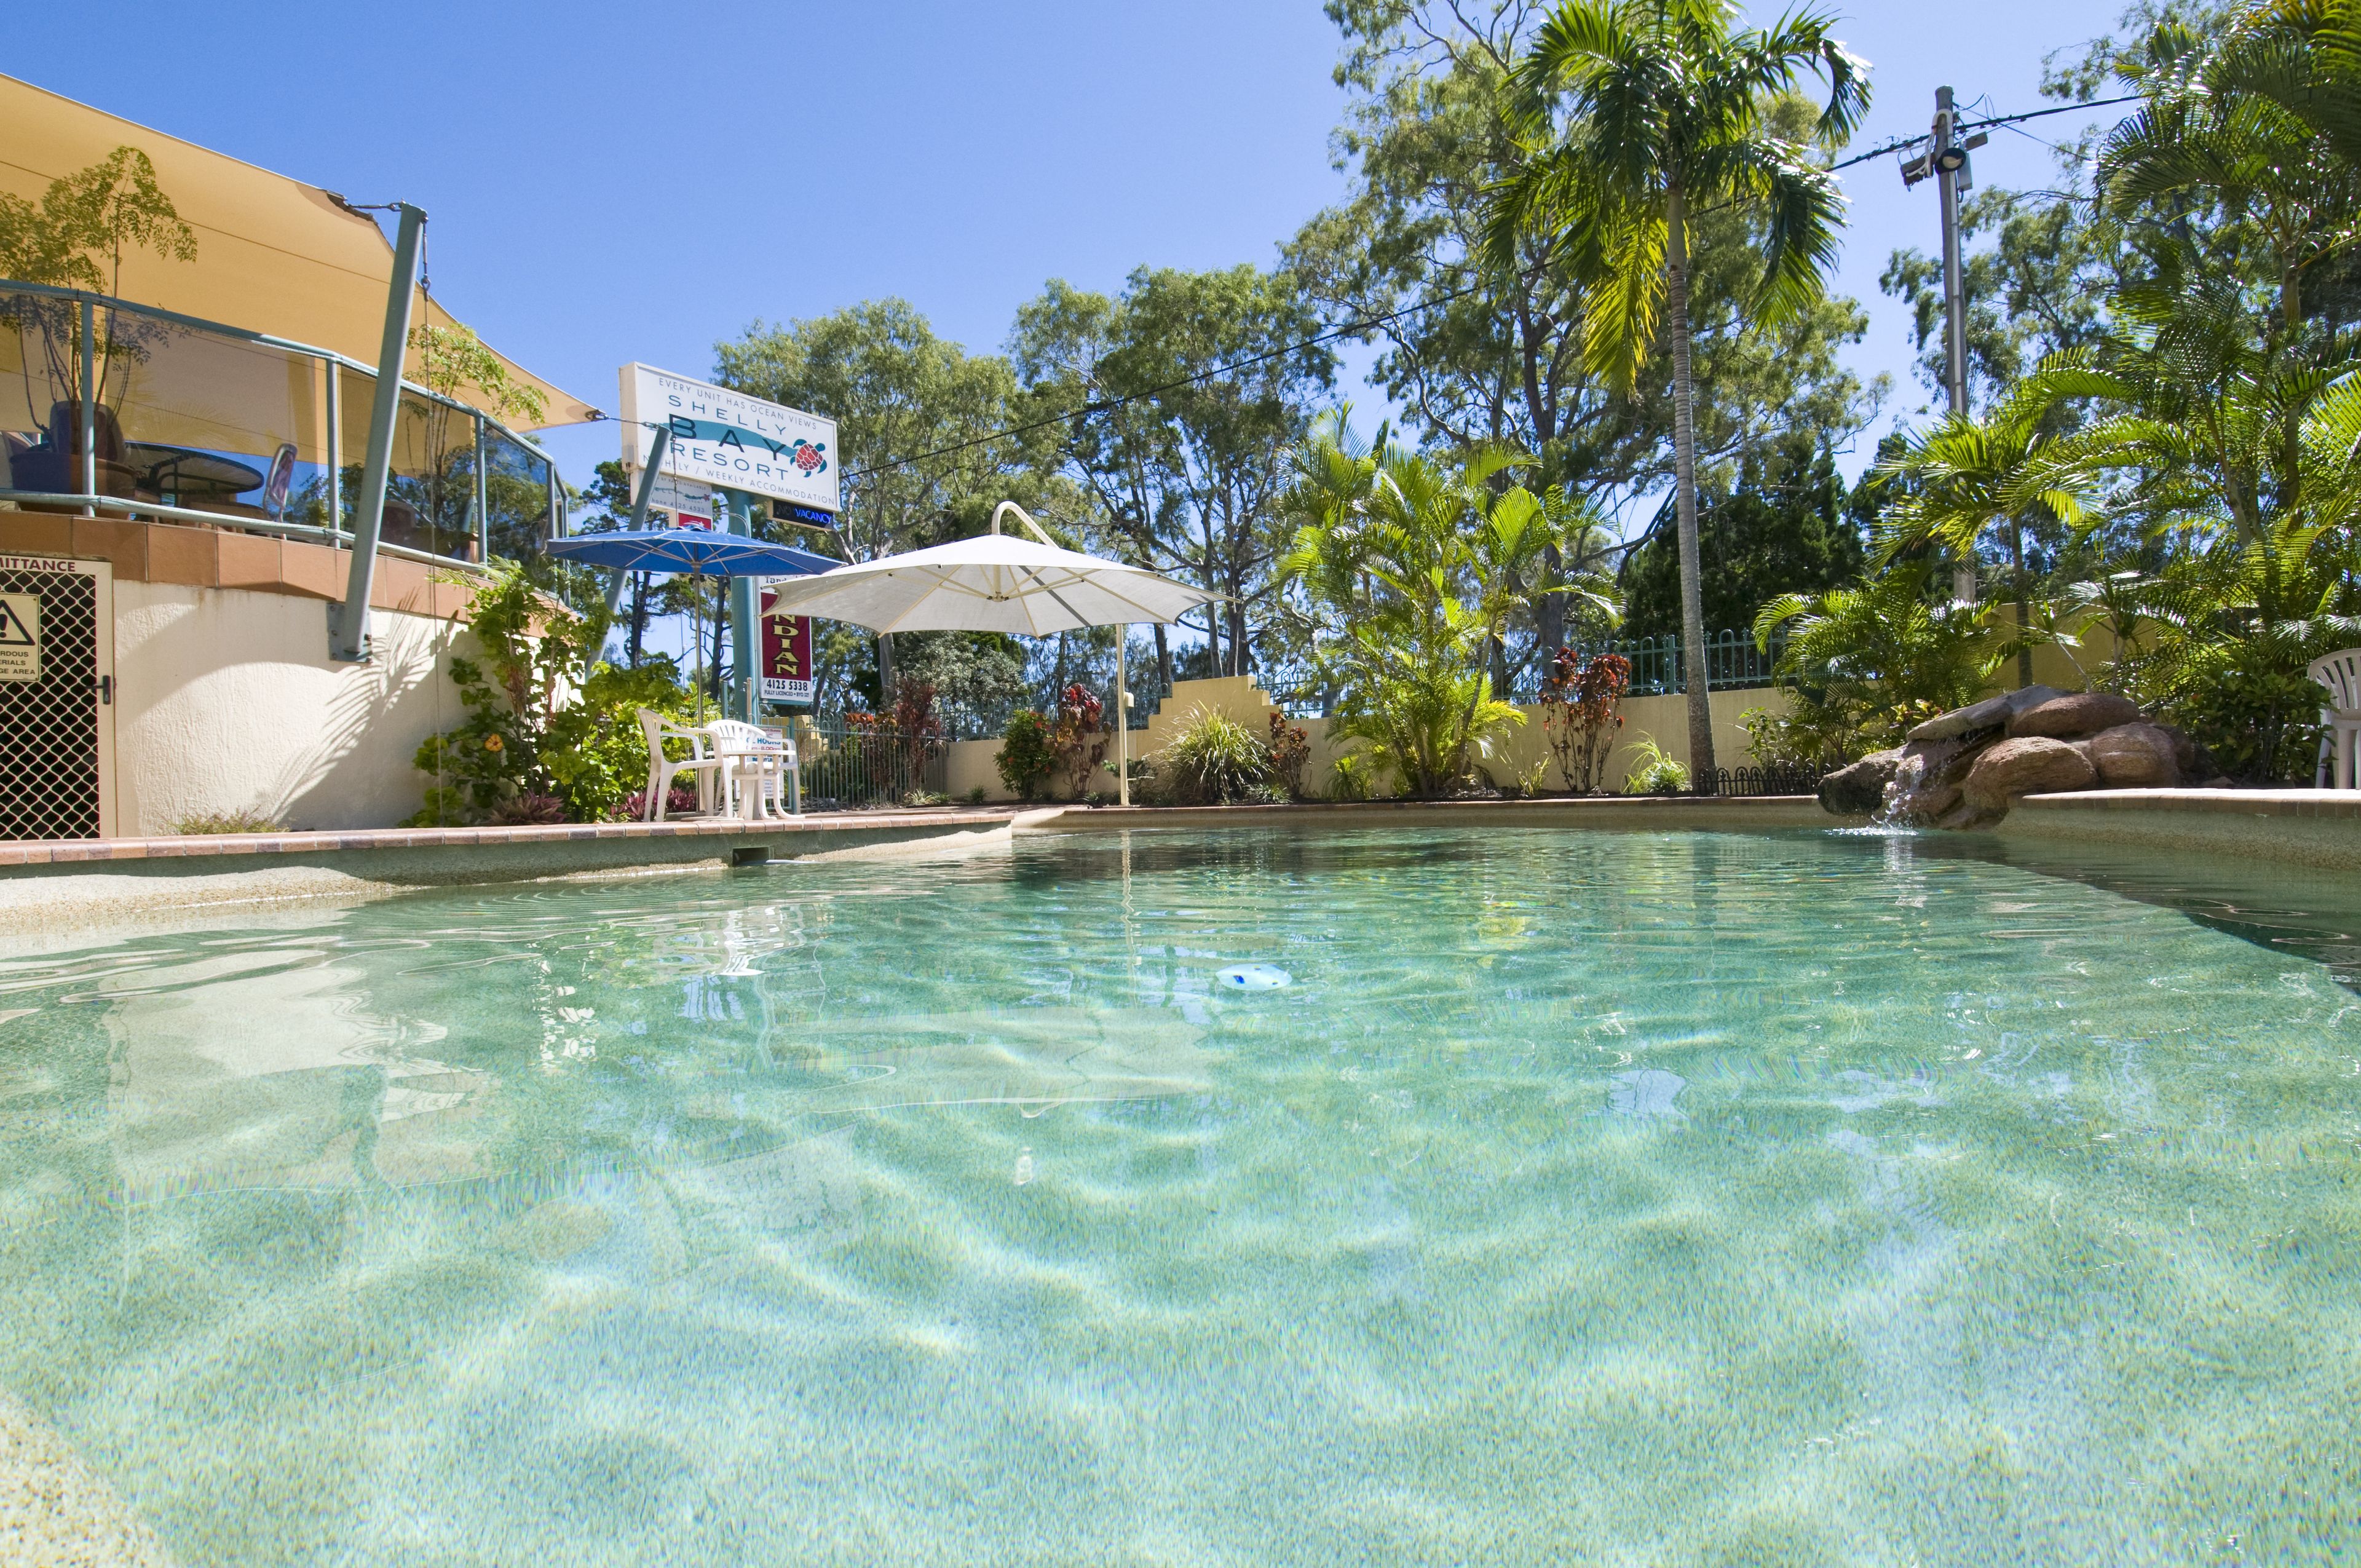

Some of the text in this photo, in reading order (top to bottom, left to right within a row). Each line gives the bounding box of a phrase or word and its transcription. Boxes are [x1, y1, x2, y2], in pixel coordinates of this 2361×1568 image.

[659, 378, 817, 430] EVERY UNIT HAS OCEAN VIEWS
[669, 395, 786, 435] SHELLY
[669, 413, 787, 461] BAY
[643, 454, 689, 472] NHLY
[706, 468, 745, 484] WEEKLY
[750, 480, 834, 505] ACCOMMODATION
[670, 442, 788, 480] RESORT
[794, 506, 832, 523] VACANCY
[773, 615, 800, 675] NDIAN
[767, 679, 808, 691] 4125 5338
